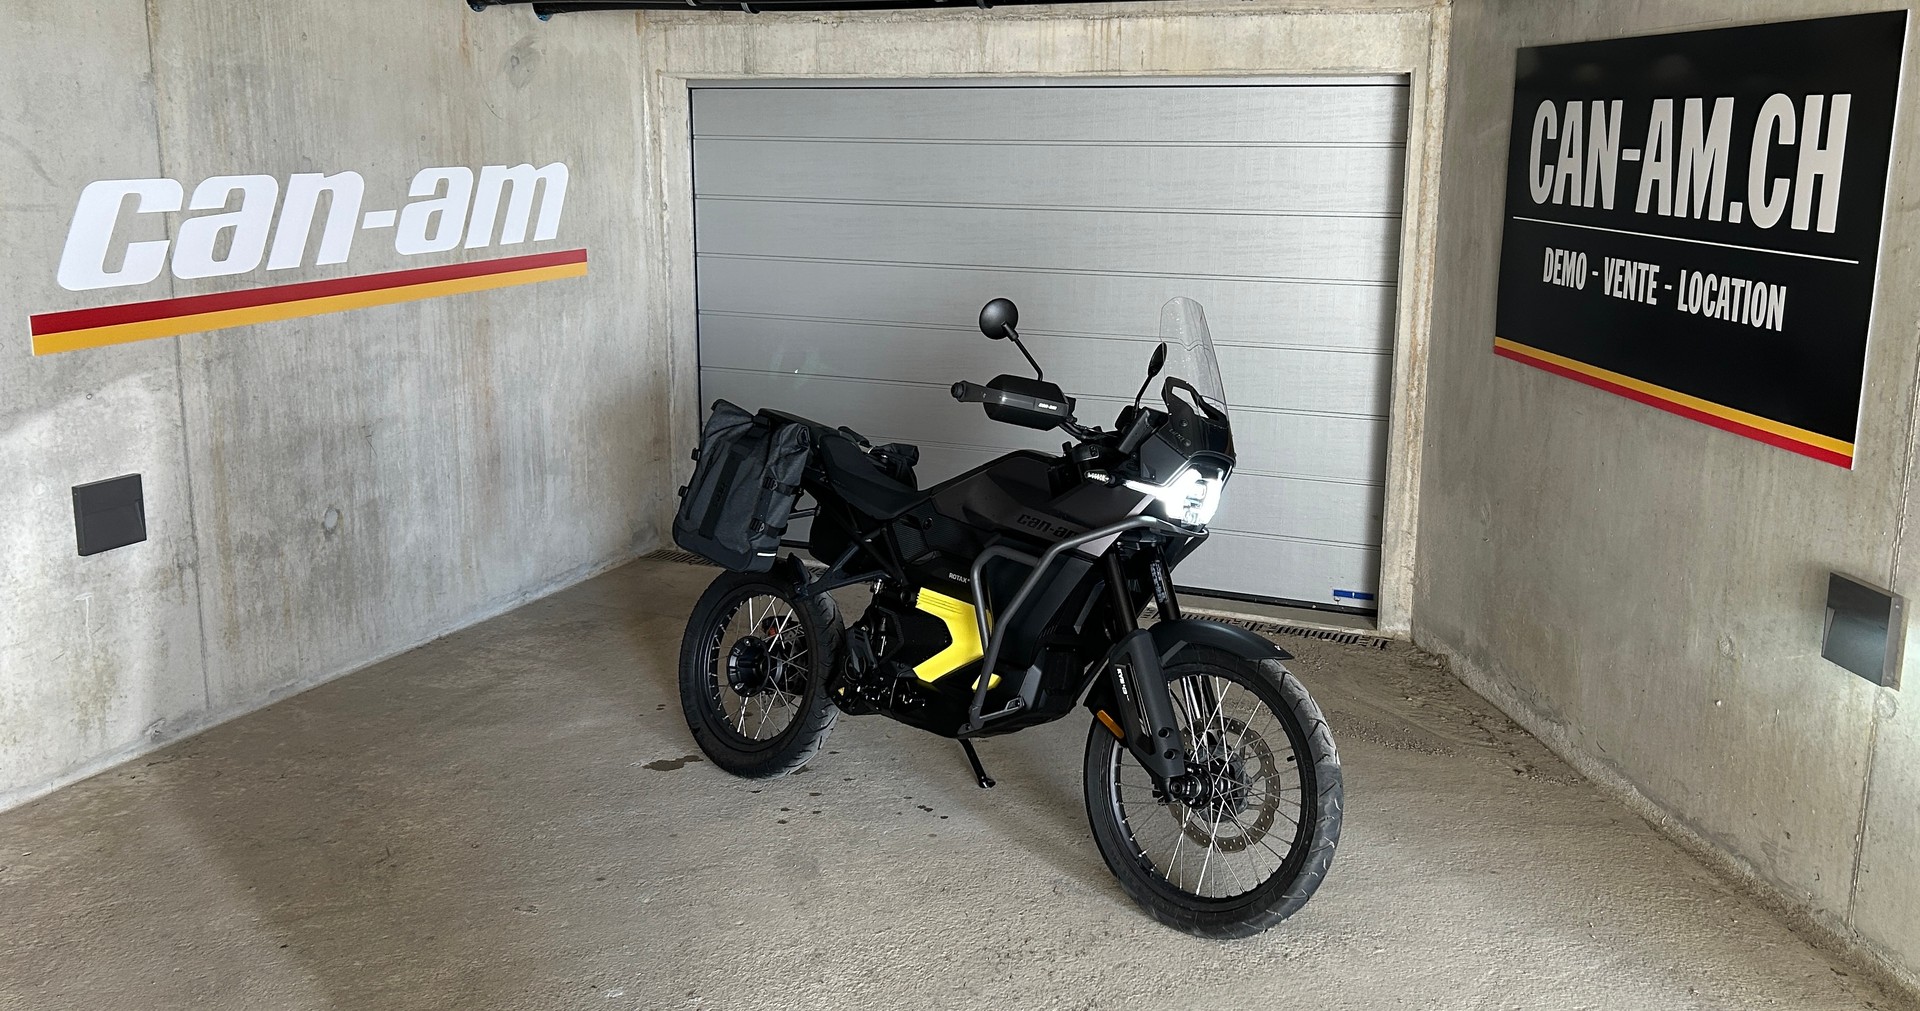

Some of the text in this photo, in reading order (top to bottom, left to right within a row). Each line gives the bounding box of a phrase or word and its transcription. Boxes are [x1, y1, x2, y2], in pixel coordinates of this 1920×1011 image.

[56, 162, 569, 291] can-am
[1528, 93, 1852, 234] CAN-AM.CH
[1542, 246, 1588, 291] DEMO
[1604, 256, 1660, 305] VENTE
[1677, 268, 1787, 332] LOCATION
